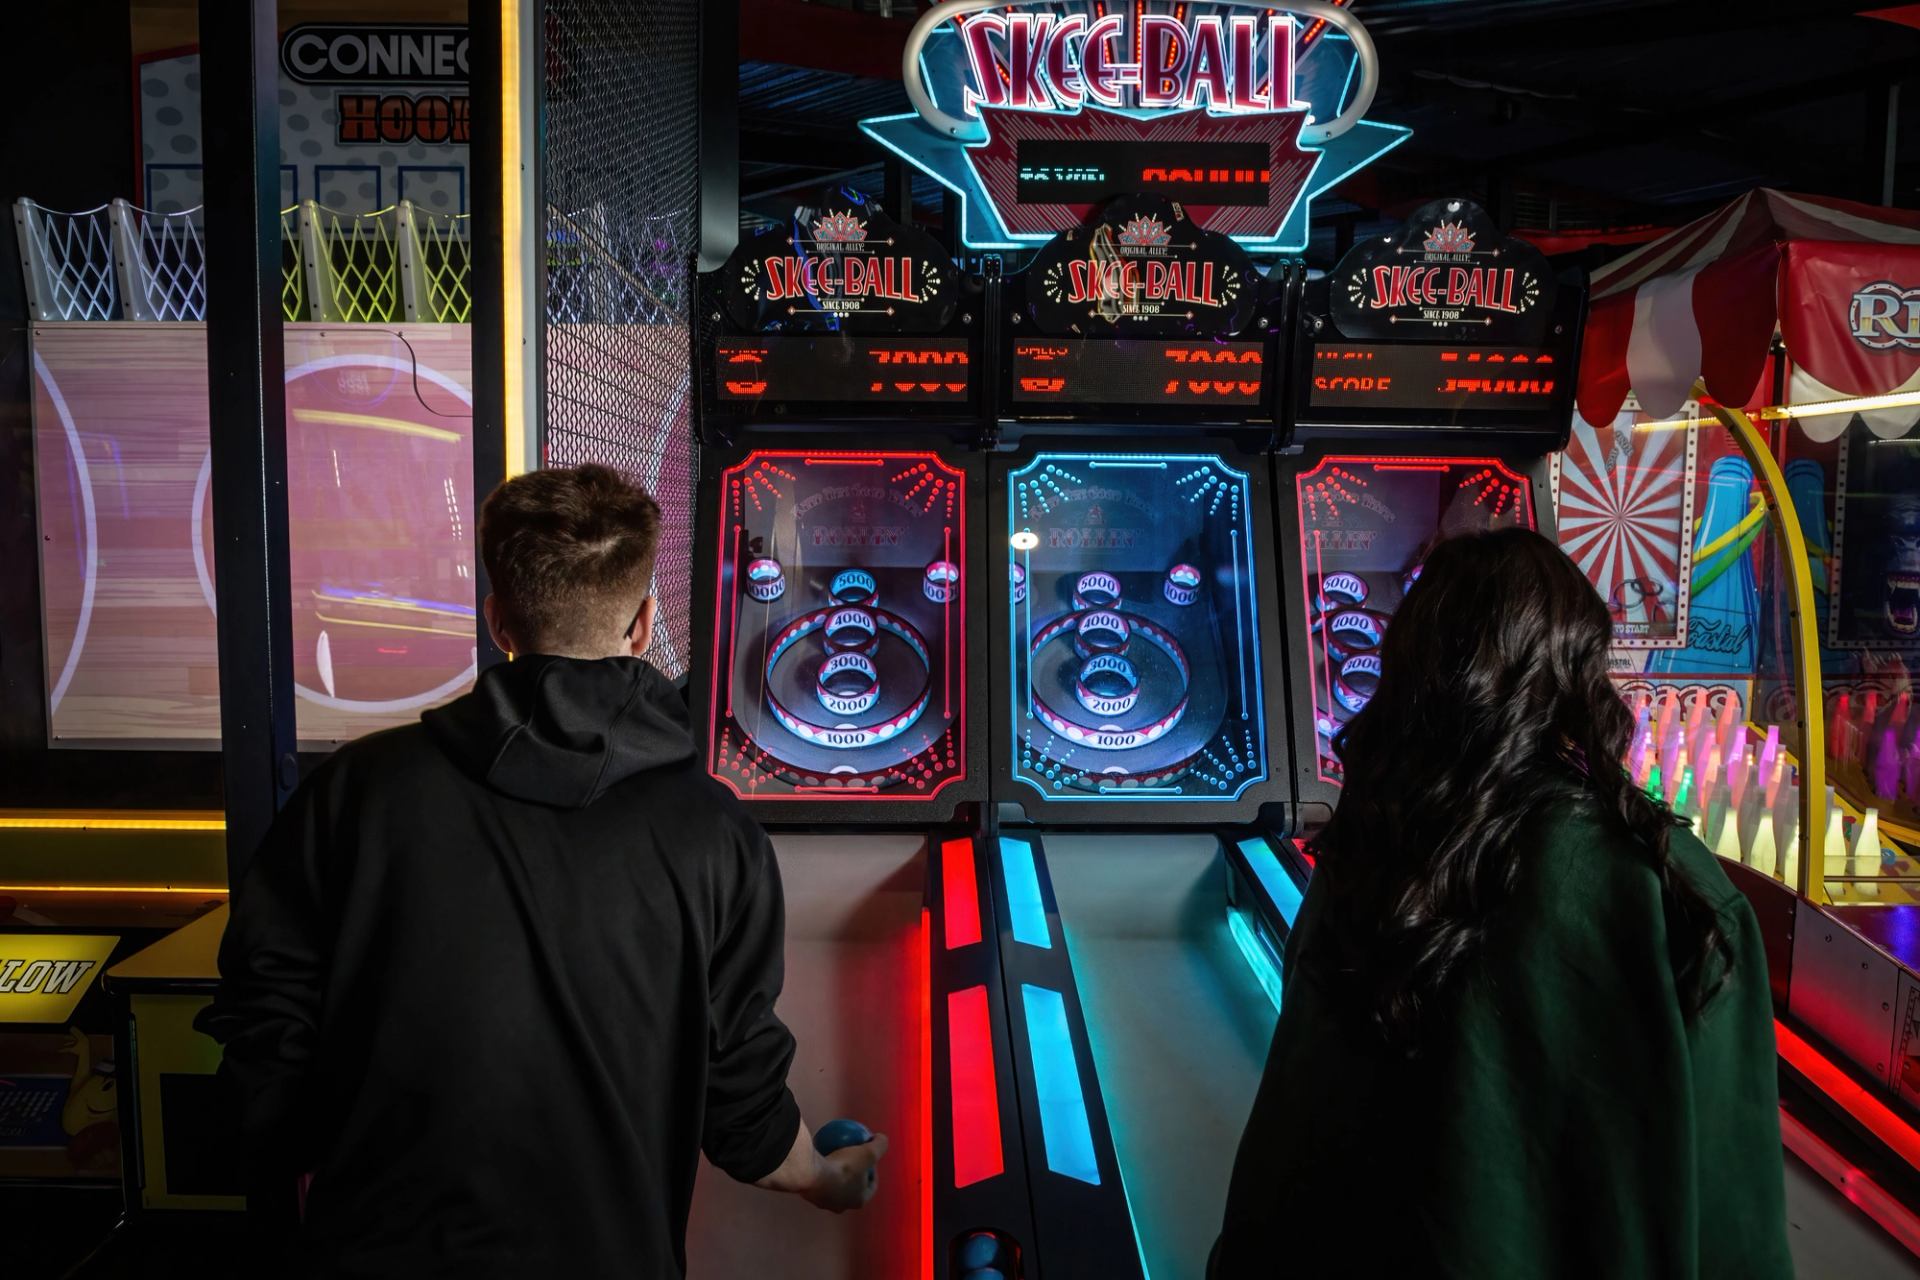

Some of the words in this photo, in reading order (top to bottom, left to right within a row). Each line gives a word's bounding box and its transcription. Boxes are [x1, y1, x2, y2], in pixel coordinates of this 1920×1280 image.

[964, 13, 1312, 117] SKEE-BALL
[765, 256, 920, 303] SKEE-BALL
[1068, 259, 1219, 307] SKEE-BALL
[1370, 265, 1518, 314] SKEE-BALL
[822, 301, 840, 310] SINCE
[841, 301, 860, 310] 1908
[1122, 304, 1140, 314] SINCE
[1141, 304, 1160, 314] 1908
[1423, 309, 1440, 319] SINCE
[1441, 310, 1459, 320] 1908
[837, 573, 874, 589] 5000
[1080, 577, 1115, 592] 5000
[834, 612, 871, 628] 4000
[1084, 615, 1120, 630] 4000
[1625, 624, 1650, 634] START
[830, 656, 868, 671] 3000
[1089, 657, 1127, 673] 3000
[829, 697, 868, 711] 2000
[1092, 697, 1132, 712] 2000
[826, 733, 865, 745] 1000
[1097, 735, 1136, 746] 1000
[0, 960, 96, 994] LOW
